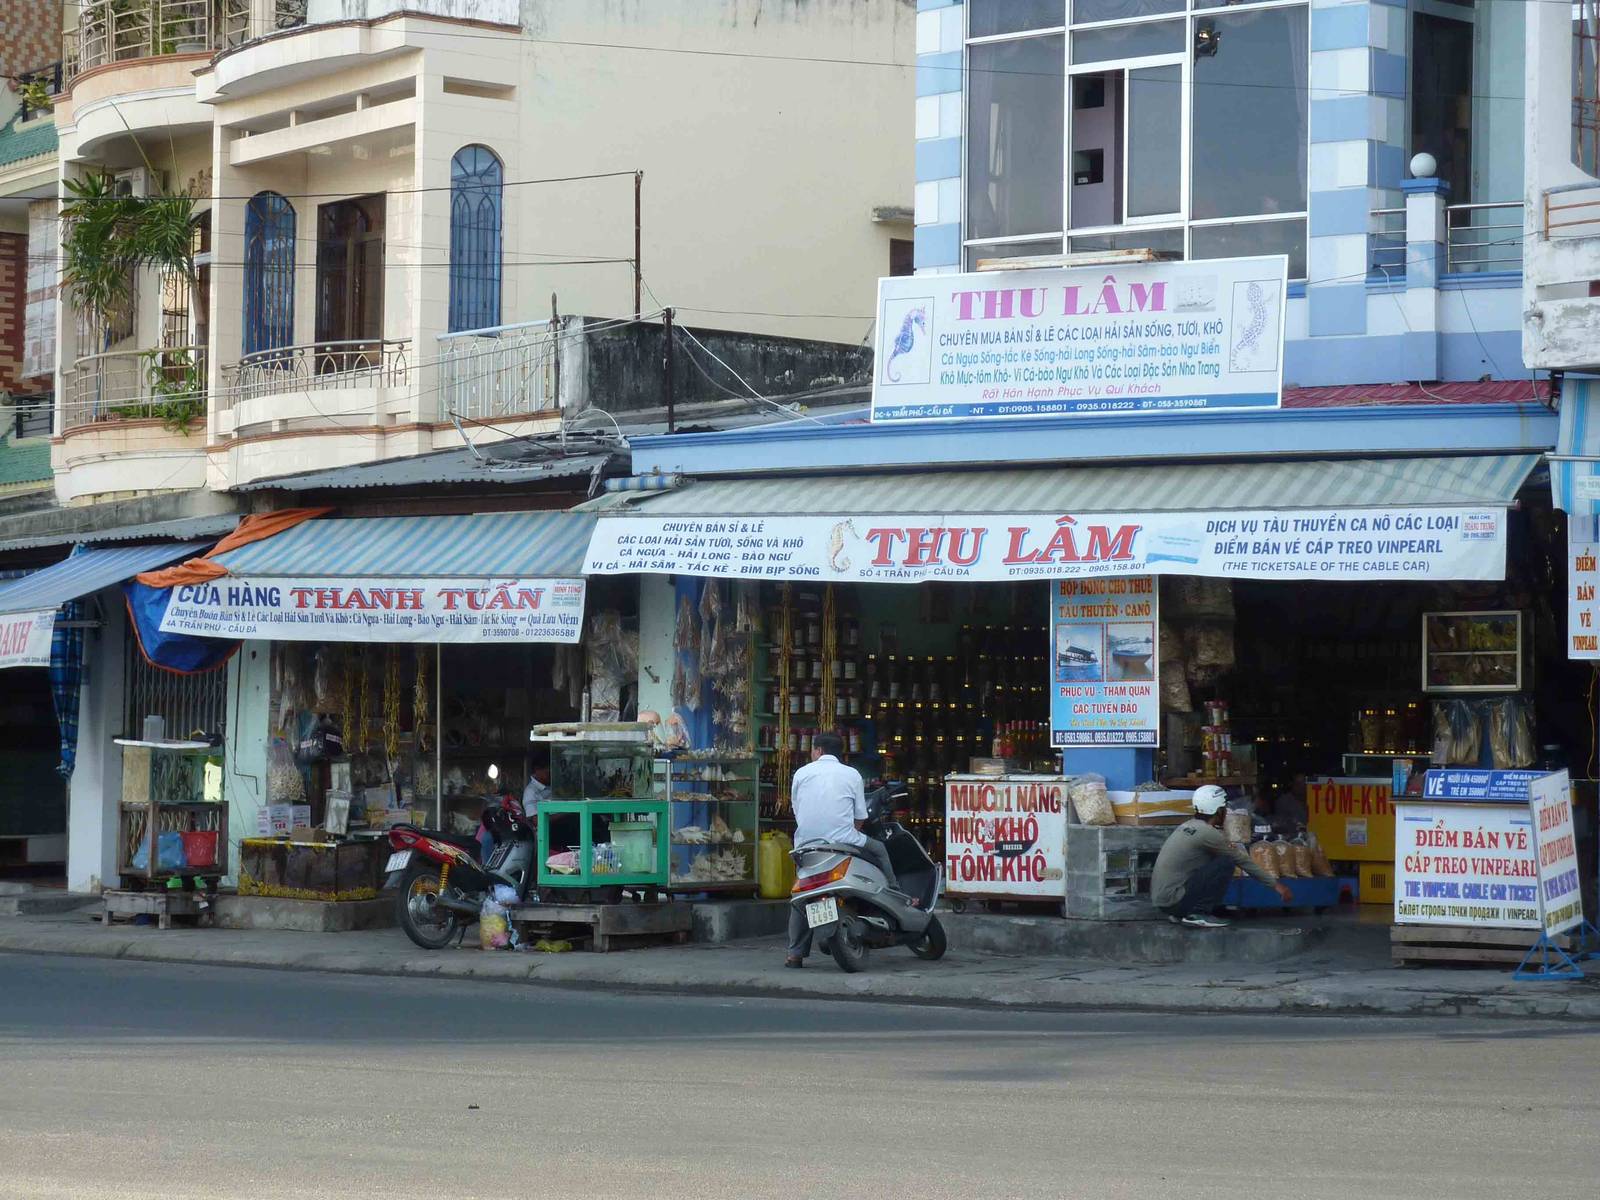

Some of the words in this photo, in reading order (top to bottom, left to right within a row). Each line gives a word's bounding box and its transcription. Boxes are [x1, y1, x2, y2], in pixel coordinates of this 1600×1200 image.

[952, 287, 1048, 320] THU
[1061, 275, 1168, 316] LÂM
[939, 329, 979, 346] CHUYÊN
[980, 333, 1002, 345] MUA
[1004, 328, 1023, 343] BÁN
[1035, 329, 1042, 341] &
[1057, 325, 1079, 340] CÁC
[1082, 326, 1102, 342] LOẠI
[1105, 321, 1121, 338] HẢI
[1123, 320, 1143, 337] SẢN
[1203, 318, 1223, 335] KHÔ
[1074, 348, 1095, 362] Long
[1181, 343, 1199, 358] Ngư
[1056, 367, 1073, 384] Ngư
[1124, 363, 1141, 380] Loại
[1179, 361, 1196, 376] Nha
[1198, 361, 1220, 379] Trang
[1088, 385, 1101, 396] Vụ
[1127, 382, 1161, 395] Khách
[662, 520, 704, 533] CHUYÊN
[705, 521, 726, 534] BÁN
[740, 523, 748, 533] &
[1206, 519, 1238, 536] DỊCH
[1241, 519, 1258, 535] VỤ
[1263, 516, 1290, 533] TÀU
[1293, 512, 1347, 532] THUYỀN
[1350, 517, 1368, 531] CA
[1372, 514, 1391, 531] NÔ
[1395, 513, 1423, 531] CÁC
[1426, 515, 1460, 533] LOẠI
[663, 533, 682, 545] HẢI
[684, 535, 705, 548] SẢN
[736, 534, 763, 548] SỐNG
[782, 536, 804, 549] KHÔ
[865, 526, 989, 568] THU
[1002, 515, 1143, 565] LÂM
[1213, 535, 1249, 555] ĐIỂM
[1252, 538, 1281, 555] BÁN
[1285, 537, 1302, 555] VÉ
[1305, 537, 1334, 555] CÁP
[1337, 540, 1373, 555] TREO
[1377, 539, 1443, 554] VINPEARL
[636, 547, 667, 559] NGỰA
[677, 548, 699, 560] HẢI
[701, 552, 731, 561] LONG
[768, 552, 793, 562] NGƯ
[1575, 548, 1597, 571] ĐIỂM
[628, 558, 648, 570] HẢI
[650, 559, 676, 570] SÂM
[740, 564, 763, 576] BÌM
[765, 566, 786, 578] BỊP
[788, 564, 821, 577] SỐNG
[875, 569, 882, 577] 4
[1222, 561, 1248, 572] (THE
[1251, 562, 1317, 572] TICKETSALE
[1320, 561, 1336, 571] OF
[1338, 561, 1359, 572] THE
[1362, 561, 1400, 572] CABLE
[1402, 560, 1430, 573] CAR)
[177, 582, 222, 607] CỬA
[227, 581, 281, 608] HÀNG
[289, 587, 426, 611] THANH
[436, 580, 546, 611] TUẤN
[1108, 578, 1127, 593] CHO
[1576, 581, 1595, 601] BÁN
[241, 612, 247, 622] &
[1080, 598, 1120, 617] THUYỀN
[1124, 600, 1151, 616] CANÔ
[1579, 609, 1592, 628] VÉ
[1572, 636, 1598, 652] VINPEARL
[1103, 686, 1127, 697] THAM
[1128, 686, 1151, 697] QUAN
[1120, 700, 1138, 714] ĐẢO
[1427, 770, 1445, 795] VÉ
[949, 781, 996, 814] MỰC
[1004, 786, 1013, 813] 1
[949, 812, 985, 845] MỰC
[994, 812, 1039, 843] KHÔ
[1415, 819, 1458, 849] ĐIỂM
[1462, 827, 1500, 850] BÁN
[1504, 828, 1528, 851] VÉ
[947, 848, 996, 882] TÔM
[1002, 849, 1047, 883] KHÔ
[1404, 851, 1431, 874] CÁP
[1433, 857, 1468, 876] TREO
[1470, 858, 1537, 878] VINPEARL
[1404, 880, 1421, 898] THE
[1421, 881, 1462, 900] VINPEARL
[1461, 883, 1489, 901] CABLE
[1489, 884, 1507, 902] CAR
[1509, 886, 1537, 903] TICKET
[1447, 906, 1468, 917] точки
[1468, 908, 1500, 923] продажи
